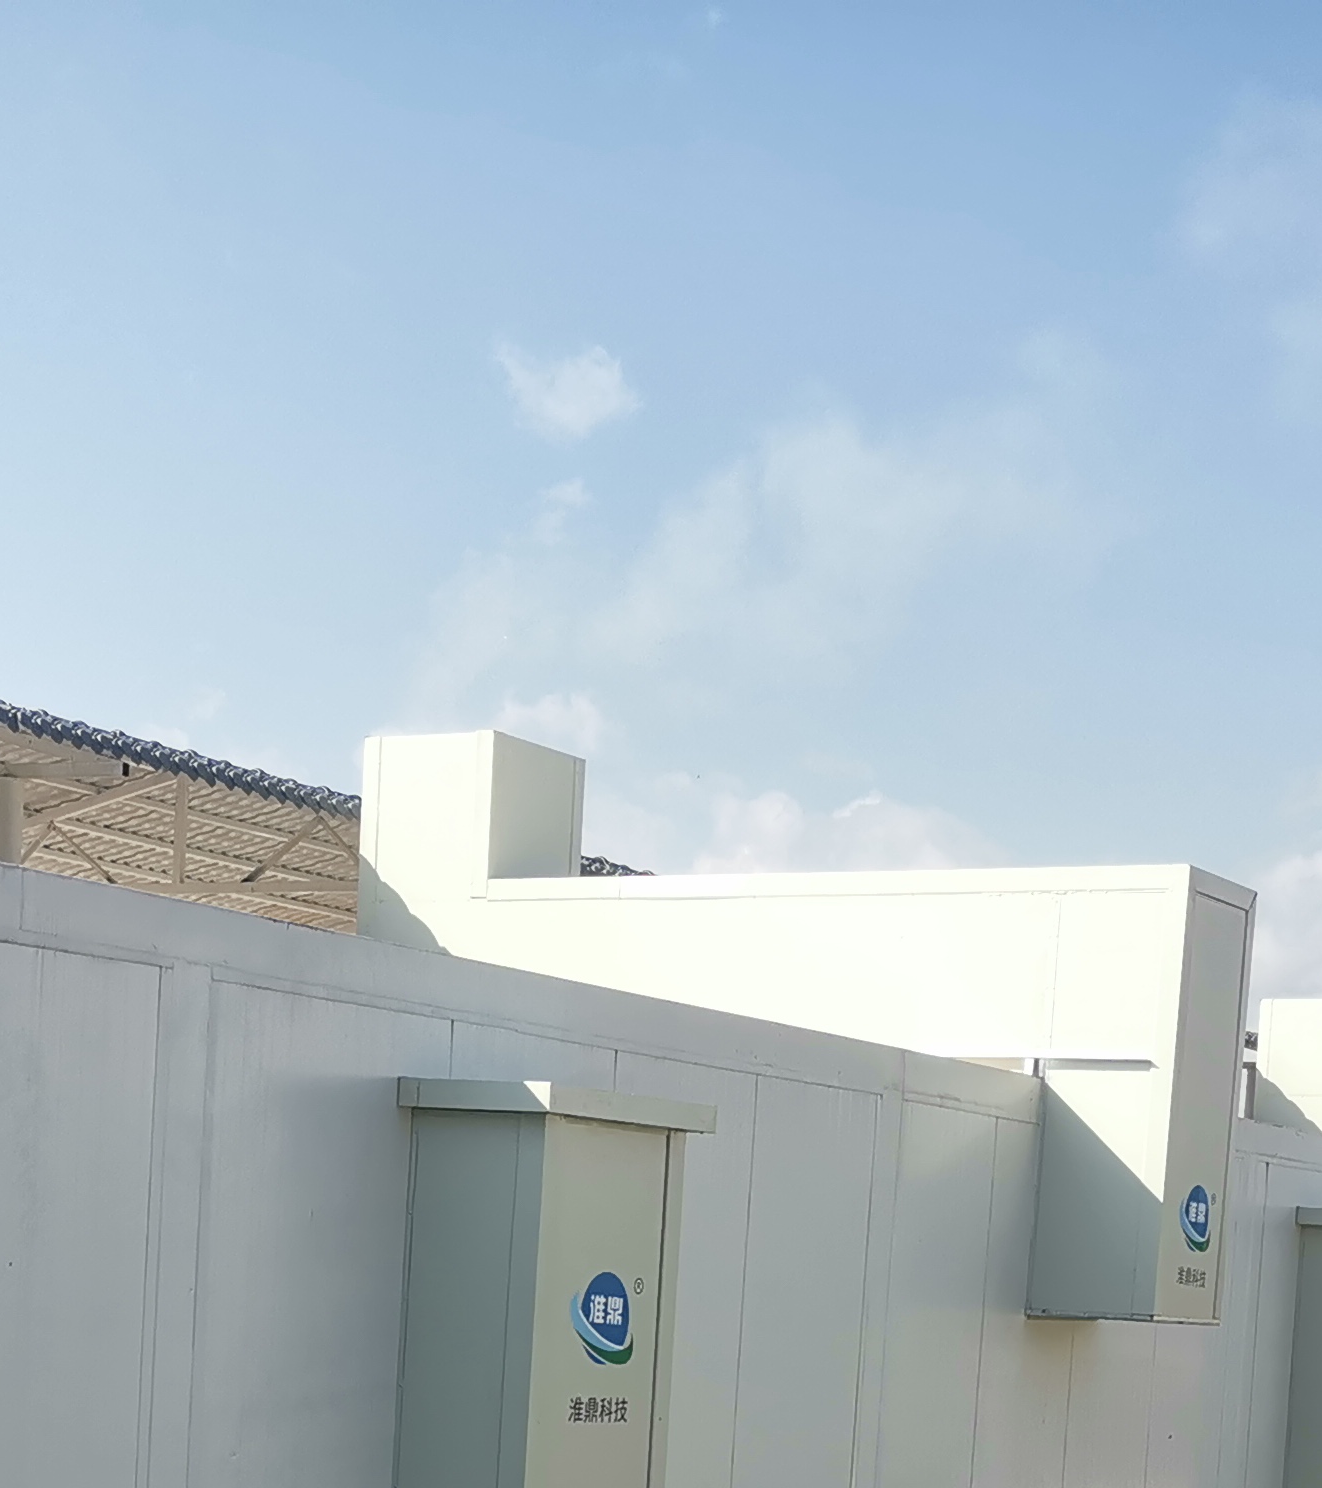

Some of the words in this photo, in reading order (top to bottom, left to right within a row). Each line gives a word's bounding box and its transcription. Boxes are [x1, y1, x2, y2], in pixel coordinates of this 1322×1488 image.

[589, 1294, 624, 1325] 淮鼎
[567, 1396, 629, 1424] 淮鼎科技
